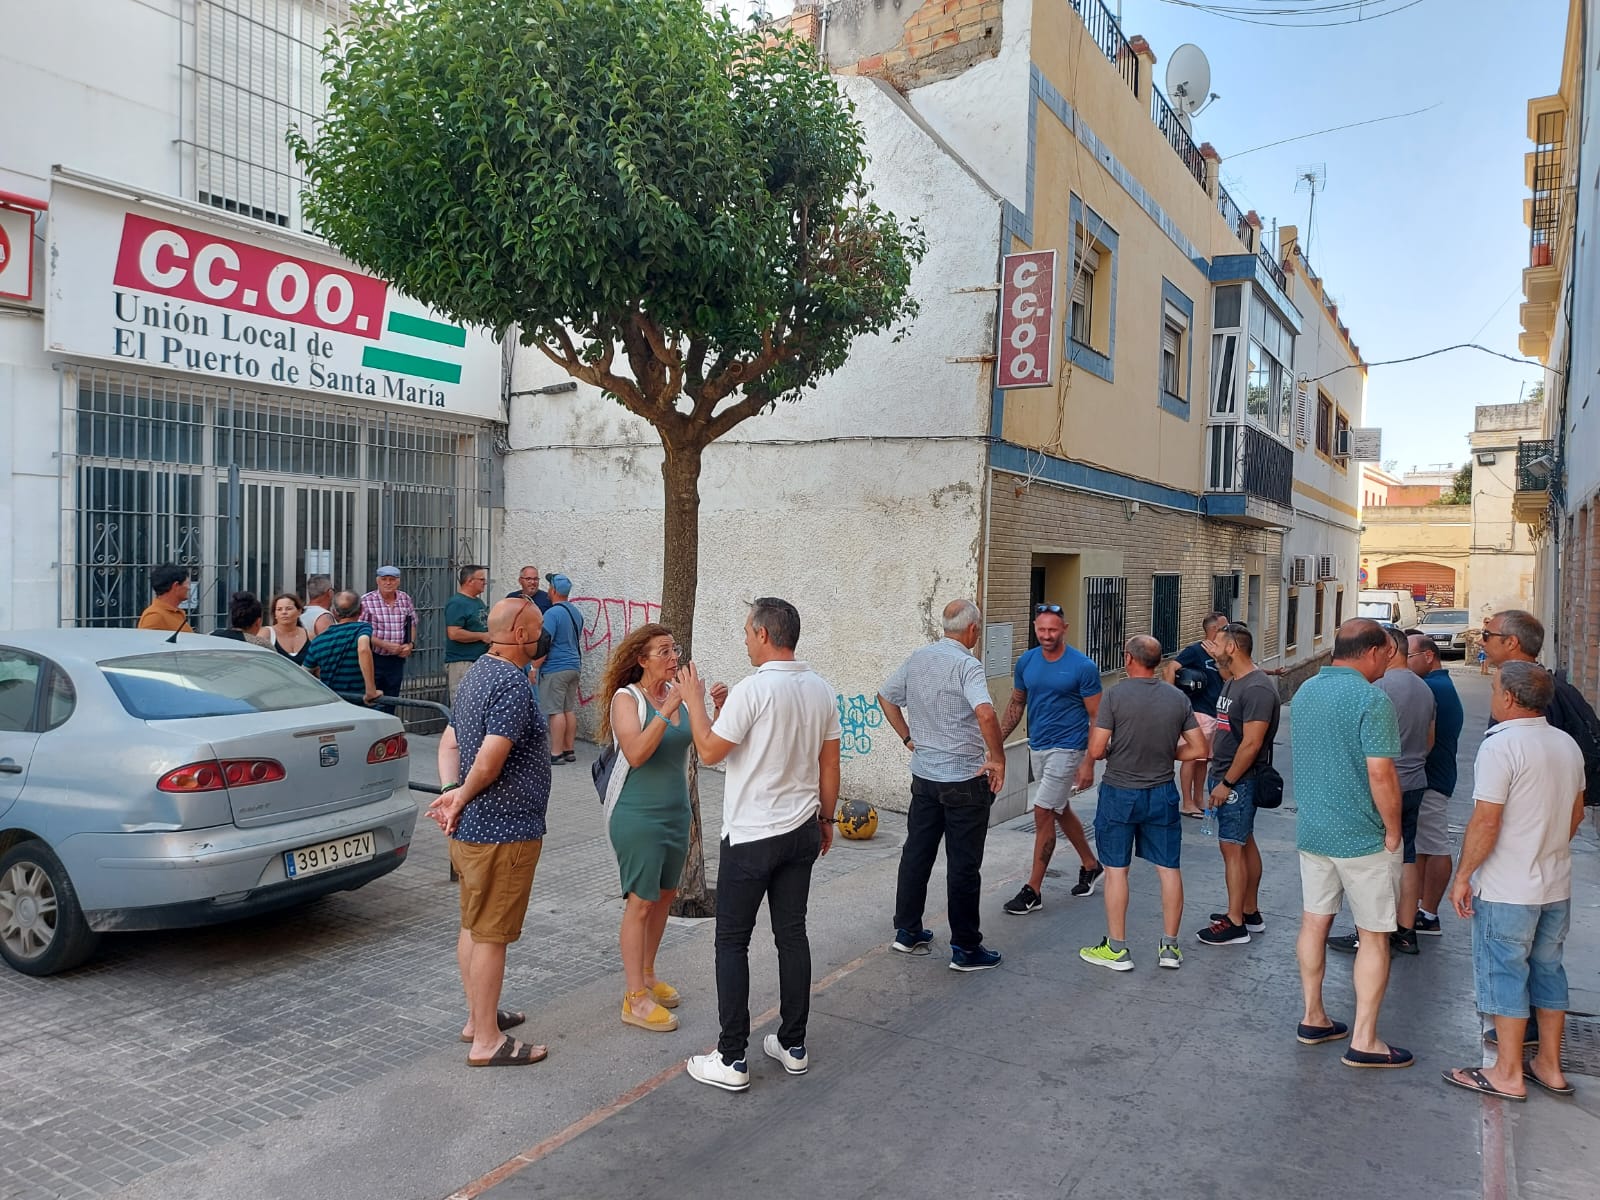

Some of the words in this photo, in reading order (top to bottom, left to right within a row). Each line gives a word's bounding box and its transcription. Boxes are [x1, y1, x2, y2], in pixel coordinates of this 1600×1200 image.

[139, 229, 370, 331] CC.OO.
[113, 292, 209, 336] Unión
[221, 312, 297, 354] Local
[306, 331, 334, 359] de
[113, 328, 146, 359] El
[161, 336, 260, 378] Puerto
[271, 355, 300, 385] de
[309, 362, 376, 397] Santa
[382, 374, 445, 408] María
[298, 845, 339, 870] 3913
[343, 835, 370, 858] CZV
